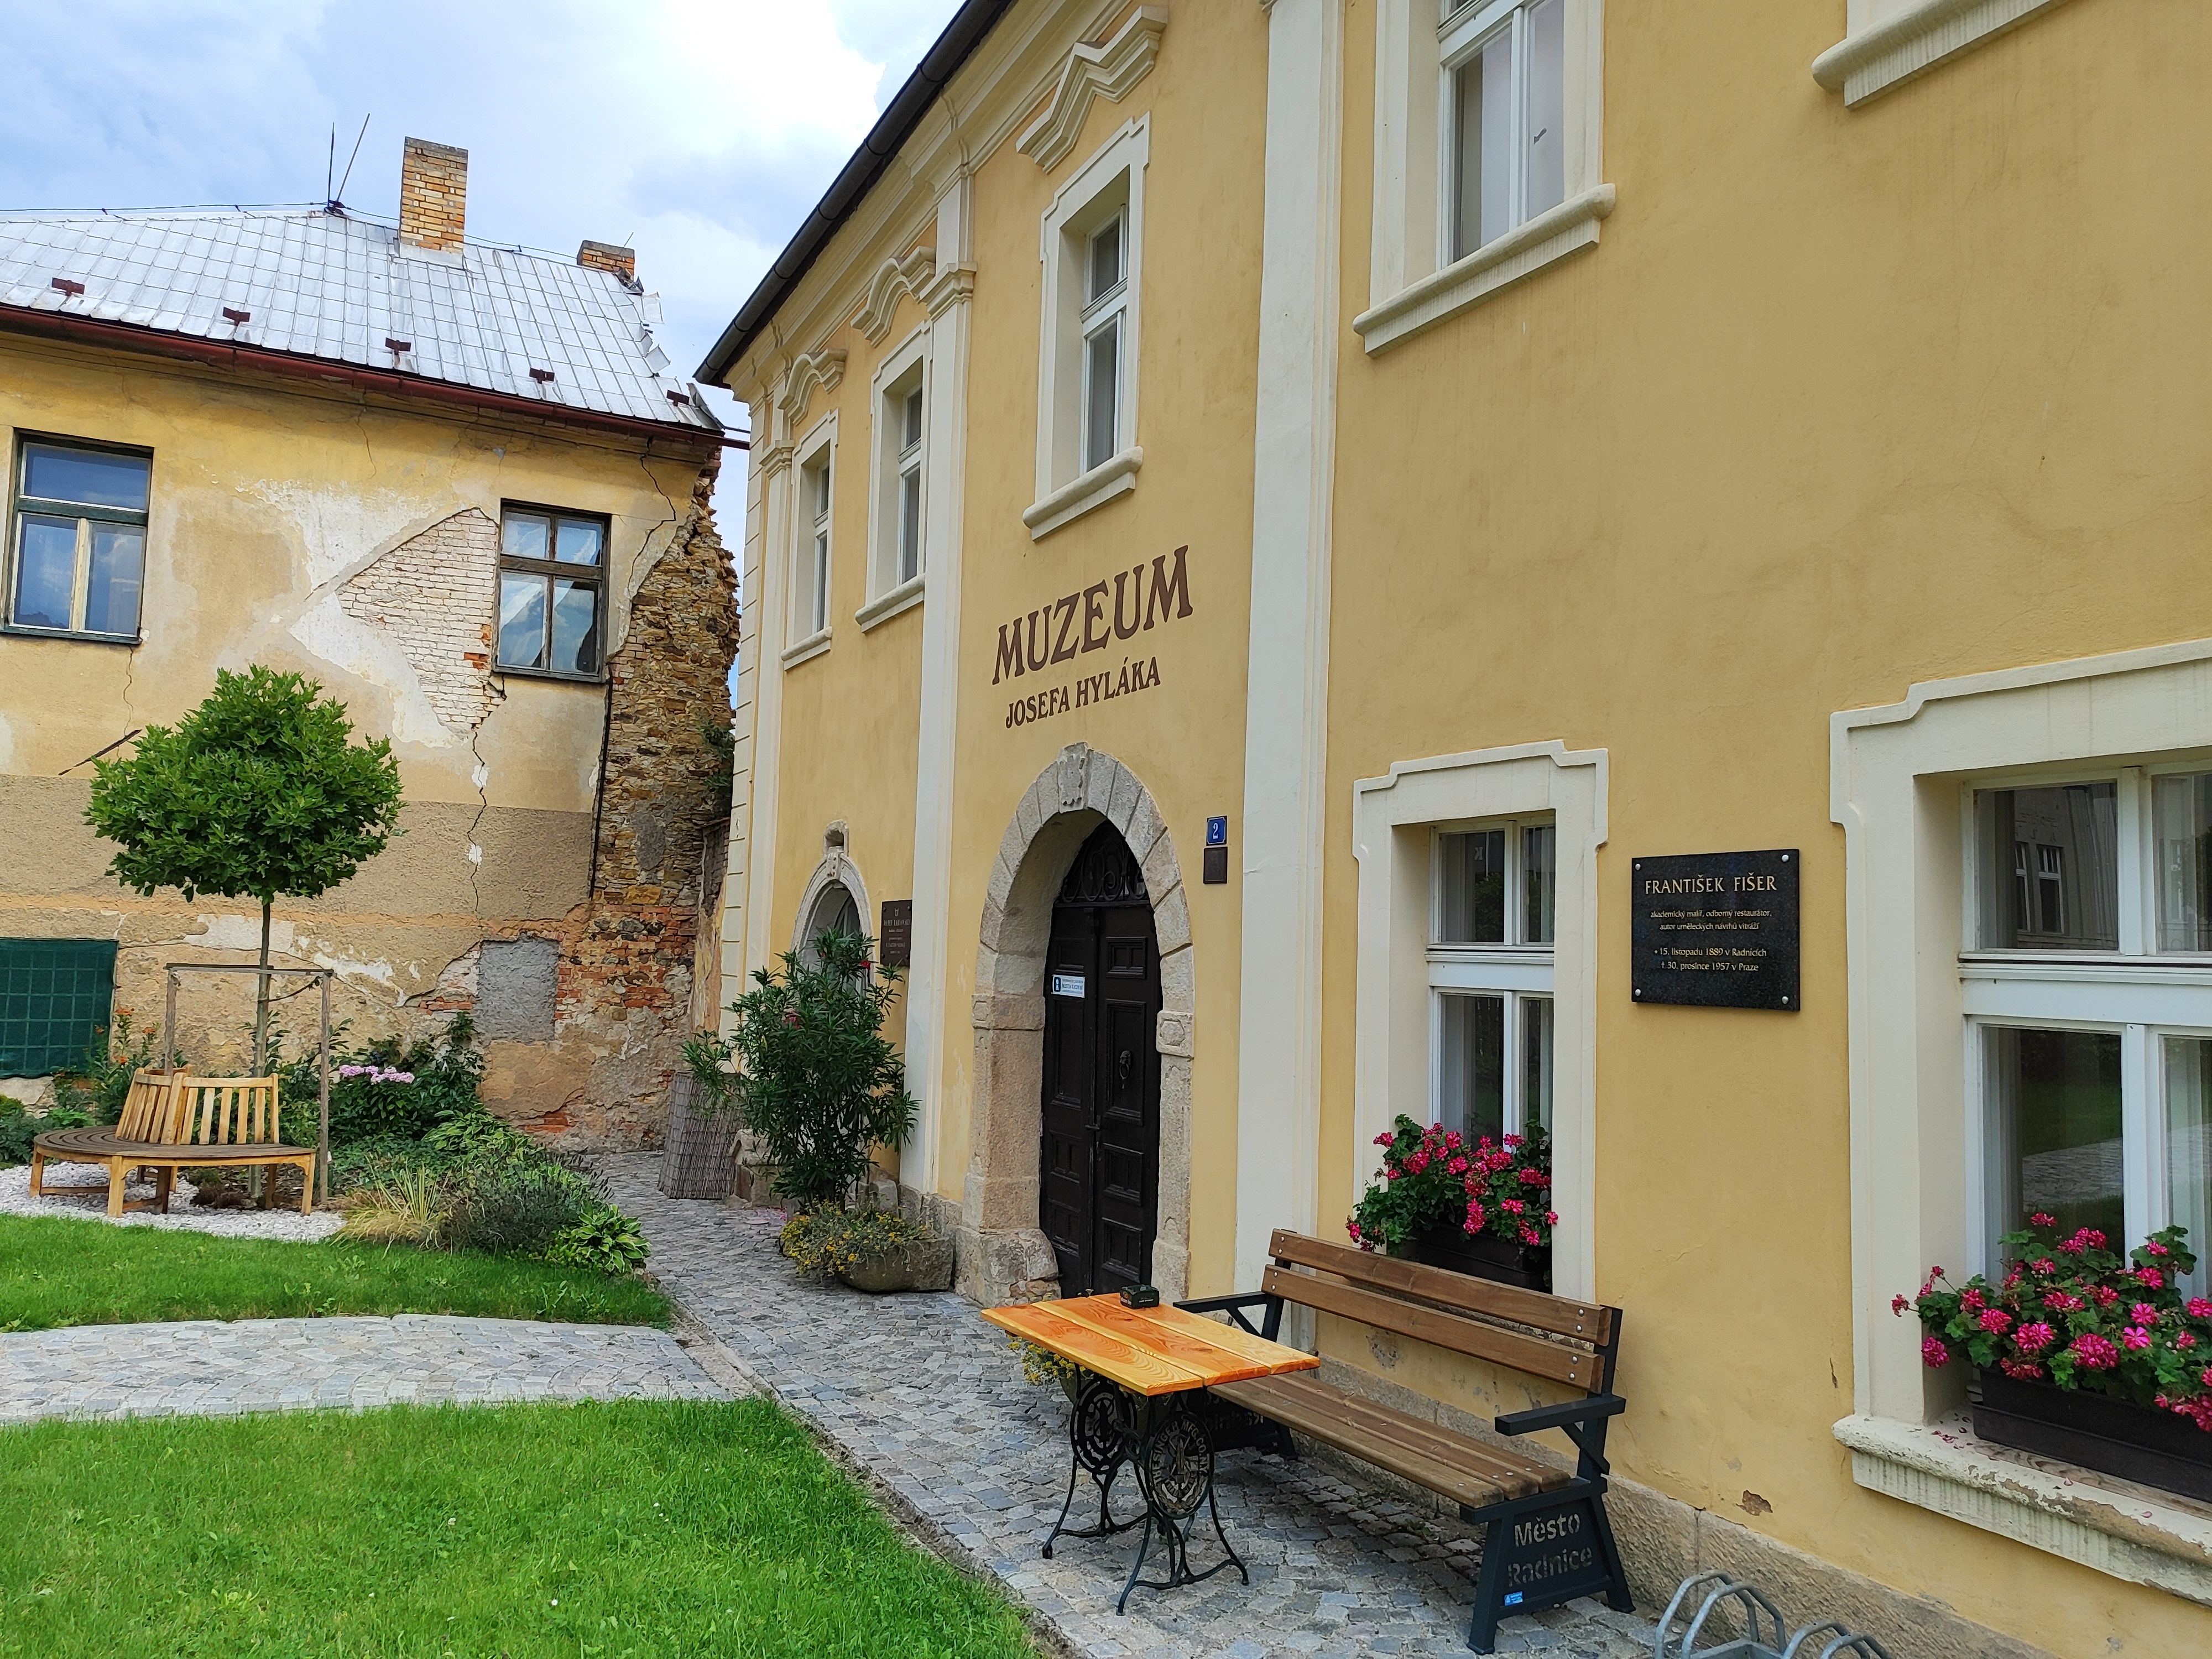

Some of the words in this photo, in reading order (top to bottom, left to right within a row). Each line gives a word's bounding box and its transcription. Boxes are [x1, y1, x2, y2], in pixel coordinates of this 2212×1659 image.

[992, 545, 1193, 686] MUZEUM
[1005, 685, 1070, 729] JOSEFA
[1075, 656, 1161, 708] HYLÁKA
[1213, 822, 1219, 839] 2
[1645, 874, 1726, 895] FRANTIŠEK
[1734, 872, 1778, 892] FIŠER
[1705, 909, 1733, 919] odborný
[1677, 922, 1714, 932] uměleckých
[1671, 947, 1703, 958] listopadu
[1705, 947, 1724, 956] 1889
[1731, 947, 1767, 957] Radnicích
[1680, 962, 1710, 972] prosince
[1712, 962, 1731, 971] 1957
[1739, 963, 1759, 972] Praze
[1514, 1513, 1580, 1548] Město
[1507, 1547, 1593, 1588] Radnice
